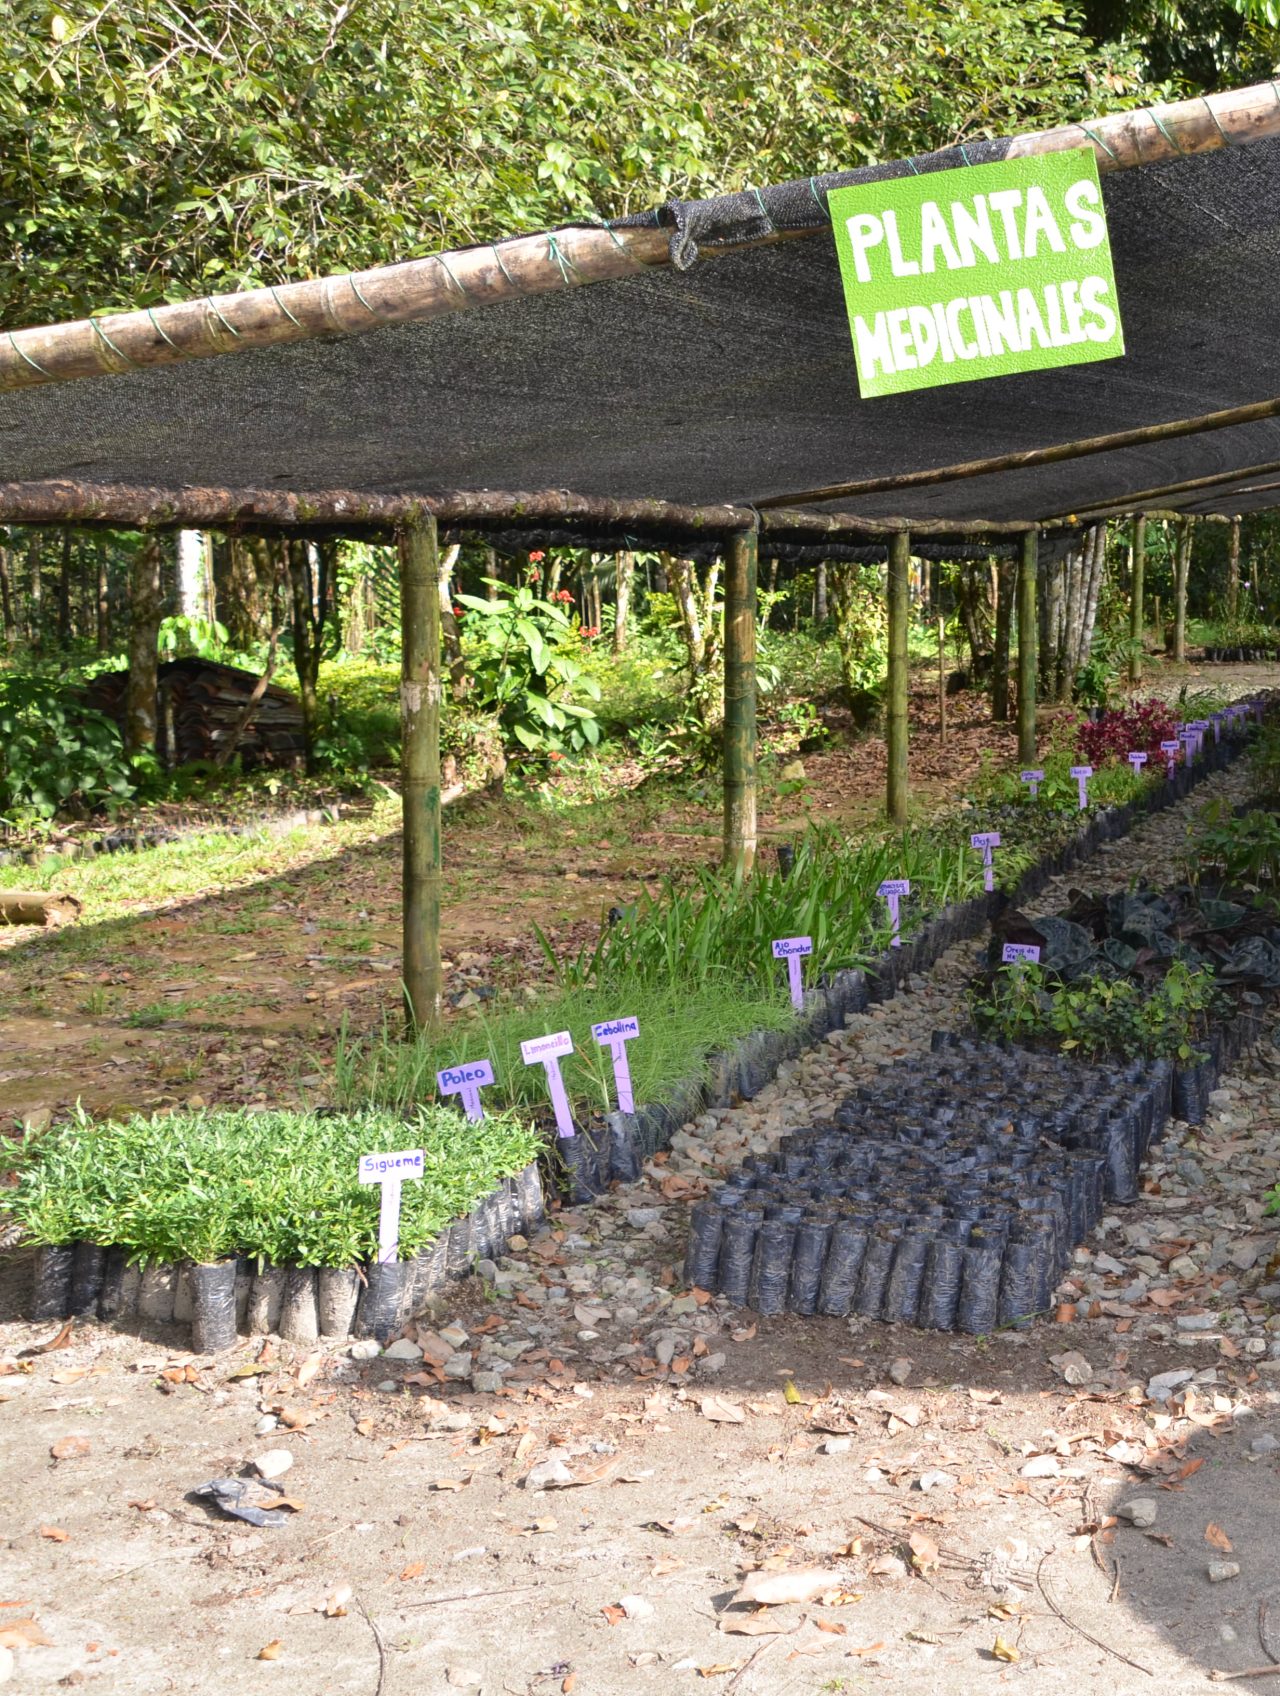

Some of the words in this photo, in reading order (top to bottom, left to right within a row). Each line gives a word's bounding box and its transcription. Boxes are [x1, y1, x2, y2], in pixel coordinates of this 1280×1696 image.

[846, 180, 1106, 283] PLANTAS
[853, 276, 1117, 380] MEDICINALES
[441, 1069, 486, 1088] Poleo
[364, 1155, 421, 1173] Sigueme
